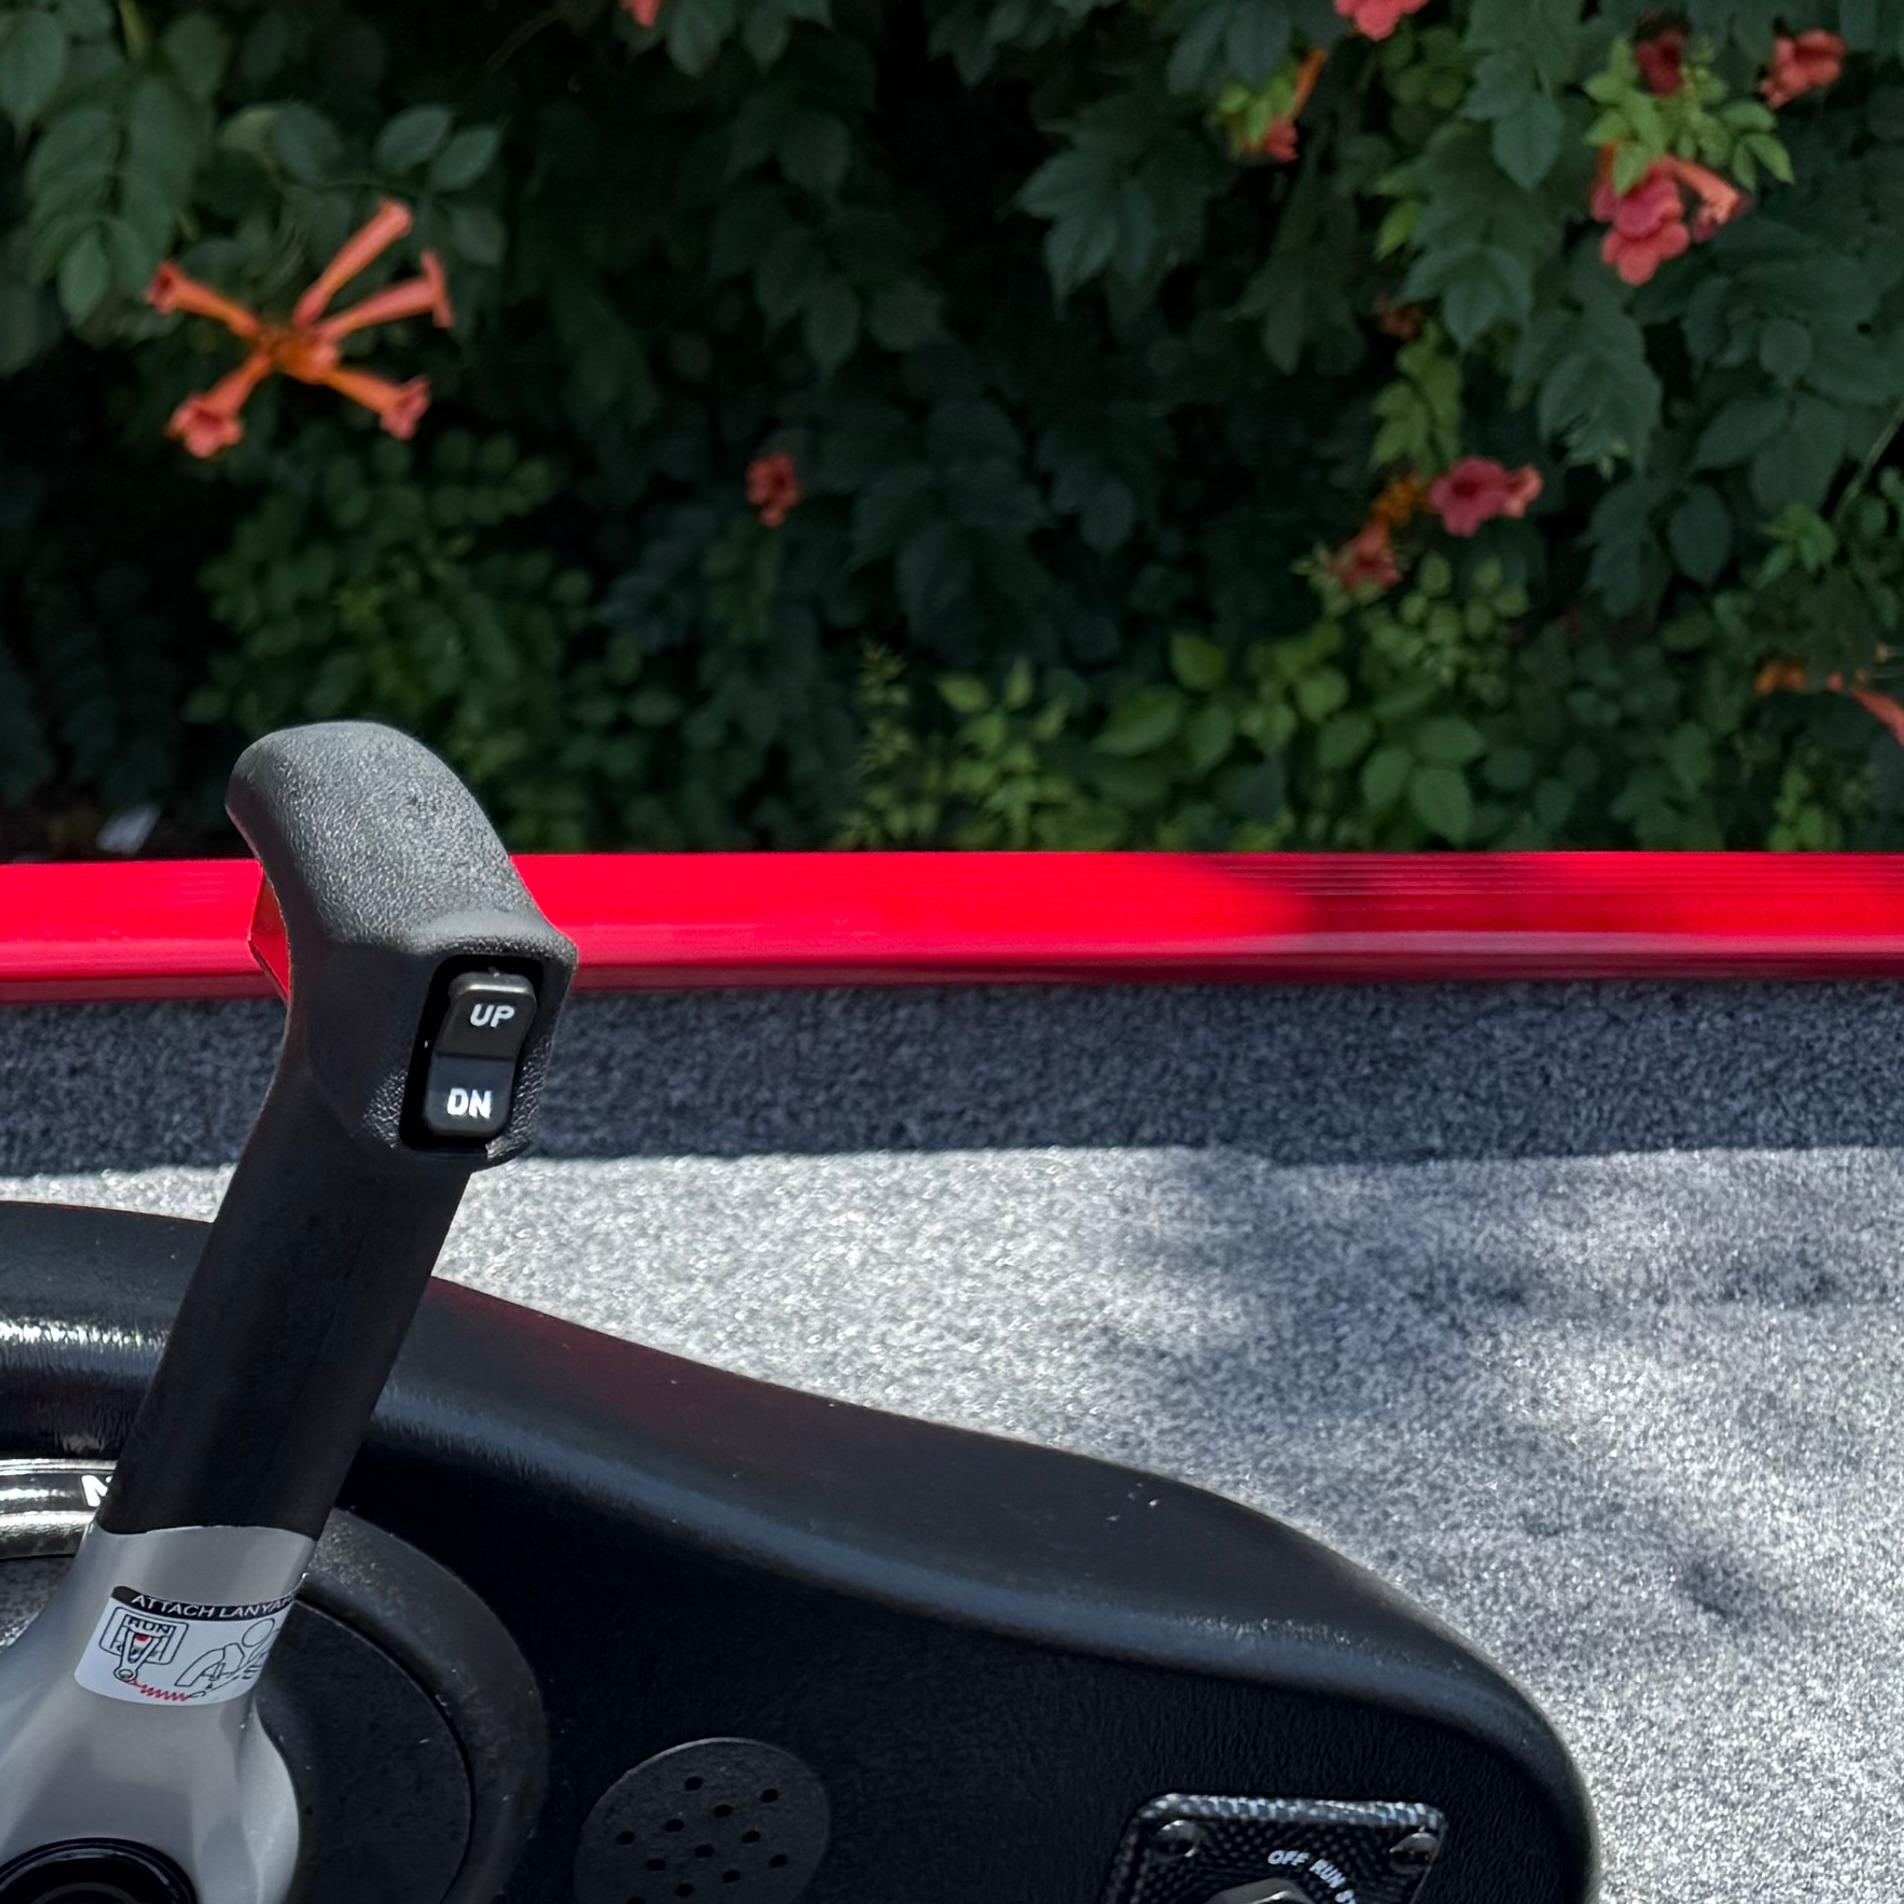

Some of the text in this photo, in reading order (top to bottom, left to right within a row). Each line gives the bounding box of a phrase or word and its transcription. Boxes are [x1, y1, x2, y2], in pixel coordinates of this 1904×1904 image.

[470, 1003, 515, 1028] UP
[447, 1087, 492, 1119] DN
[131, 1594, 215, 1619] ATTACH
[126, 1615, 173, 1634] RUN
[1268, 1850, 1310, 1866] OFF
[1309, 1858, 1346, 1888] RUN
